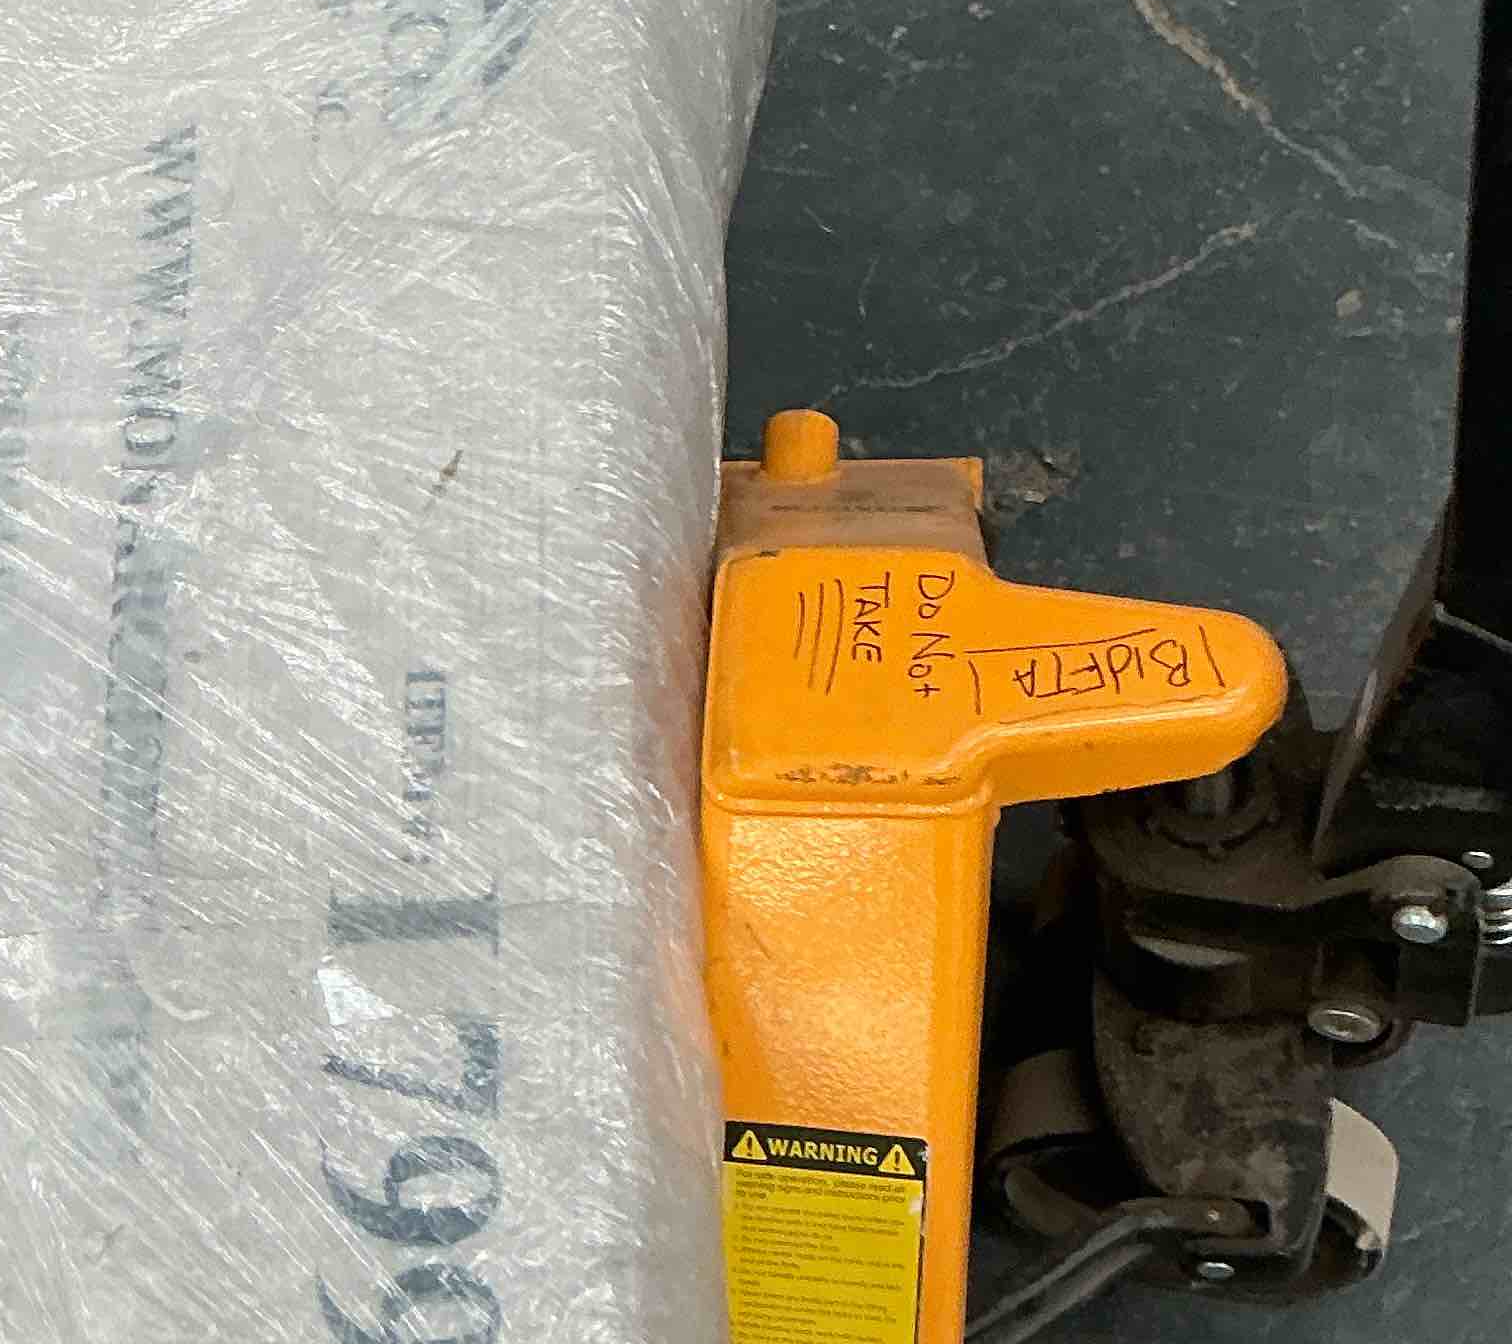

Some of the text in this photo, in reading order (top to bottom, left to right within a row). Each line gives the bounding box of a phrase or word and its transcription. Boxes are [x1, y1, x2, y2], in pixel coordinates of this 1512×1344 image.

[852, 570, 890, 663] TAKE
[916, 570, 956, 620] Do
[767, 1136, 879, 1168] WARNING
